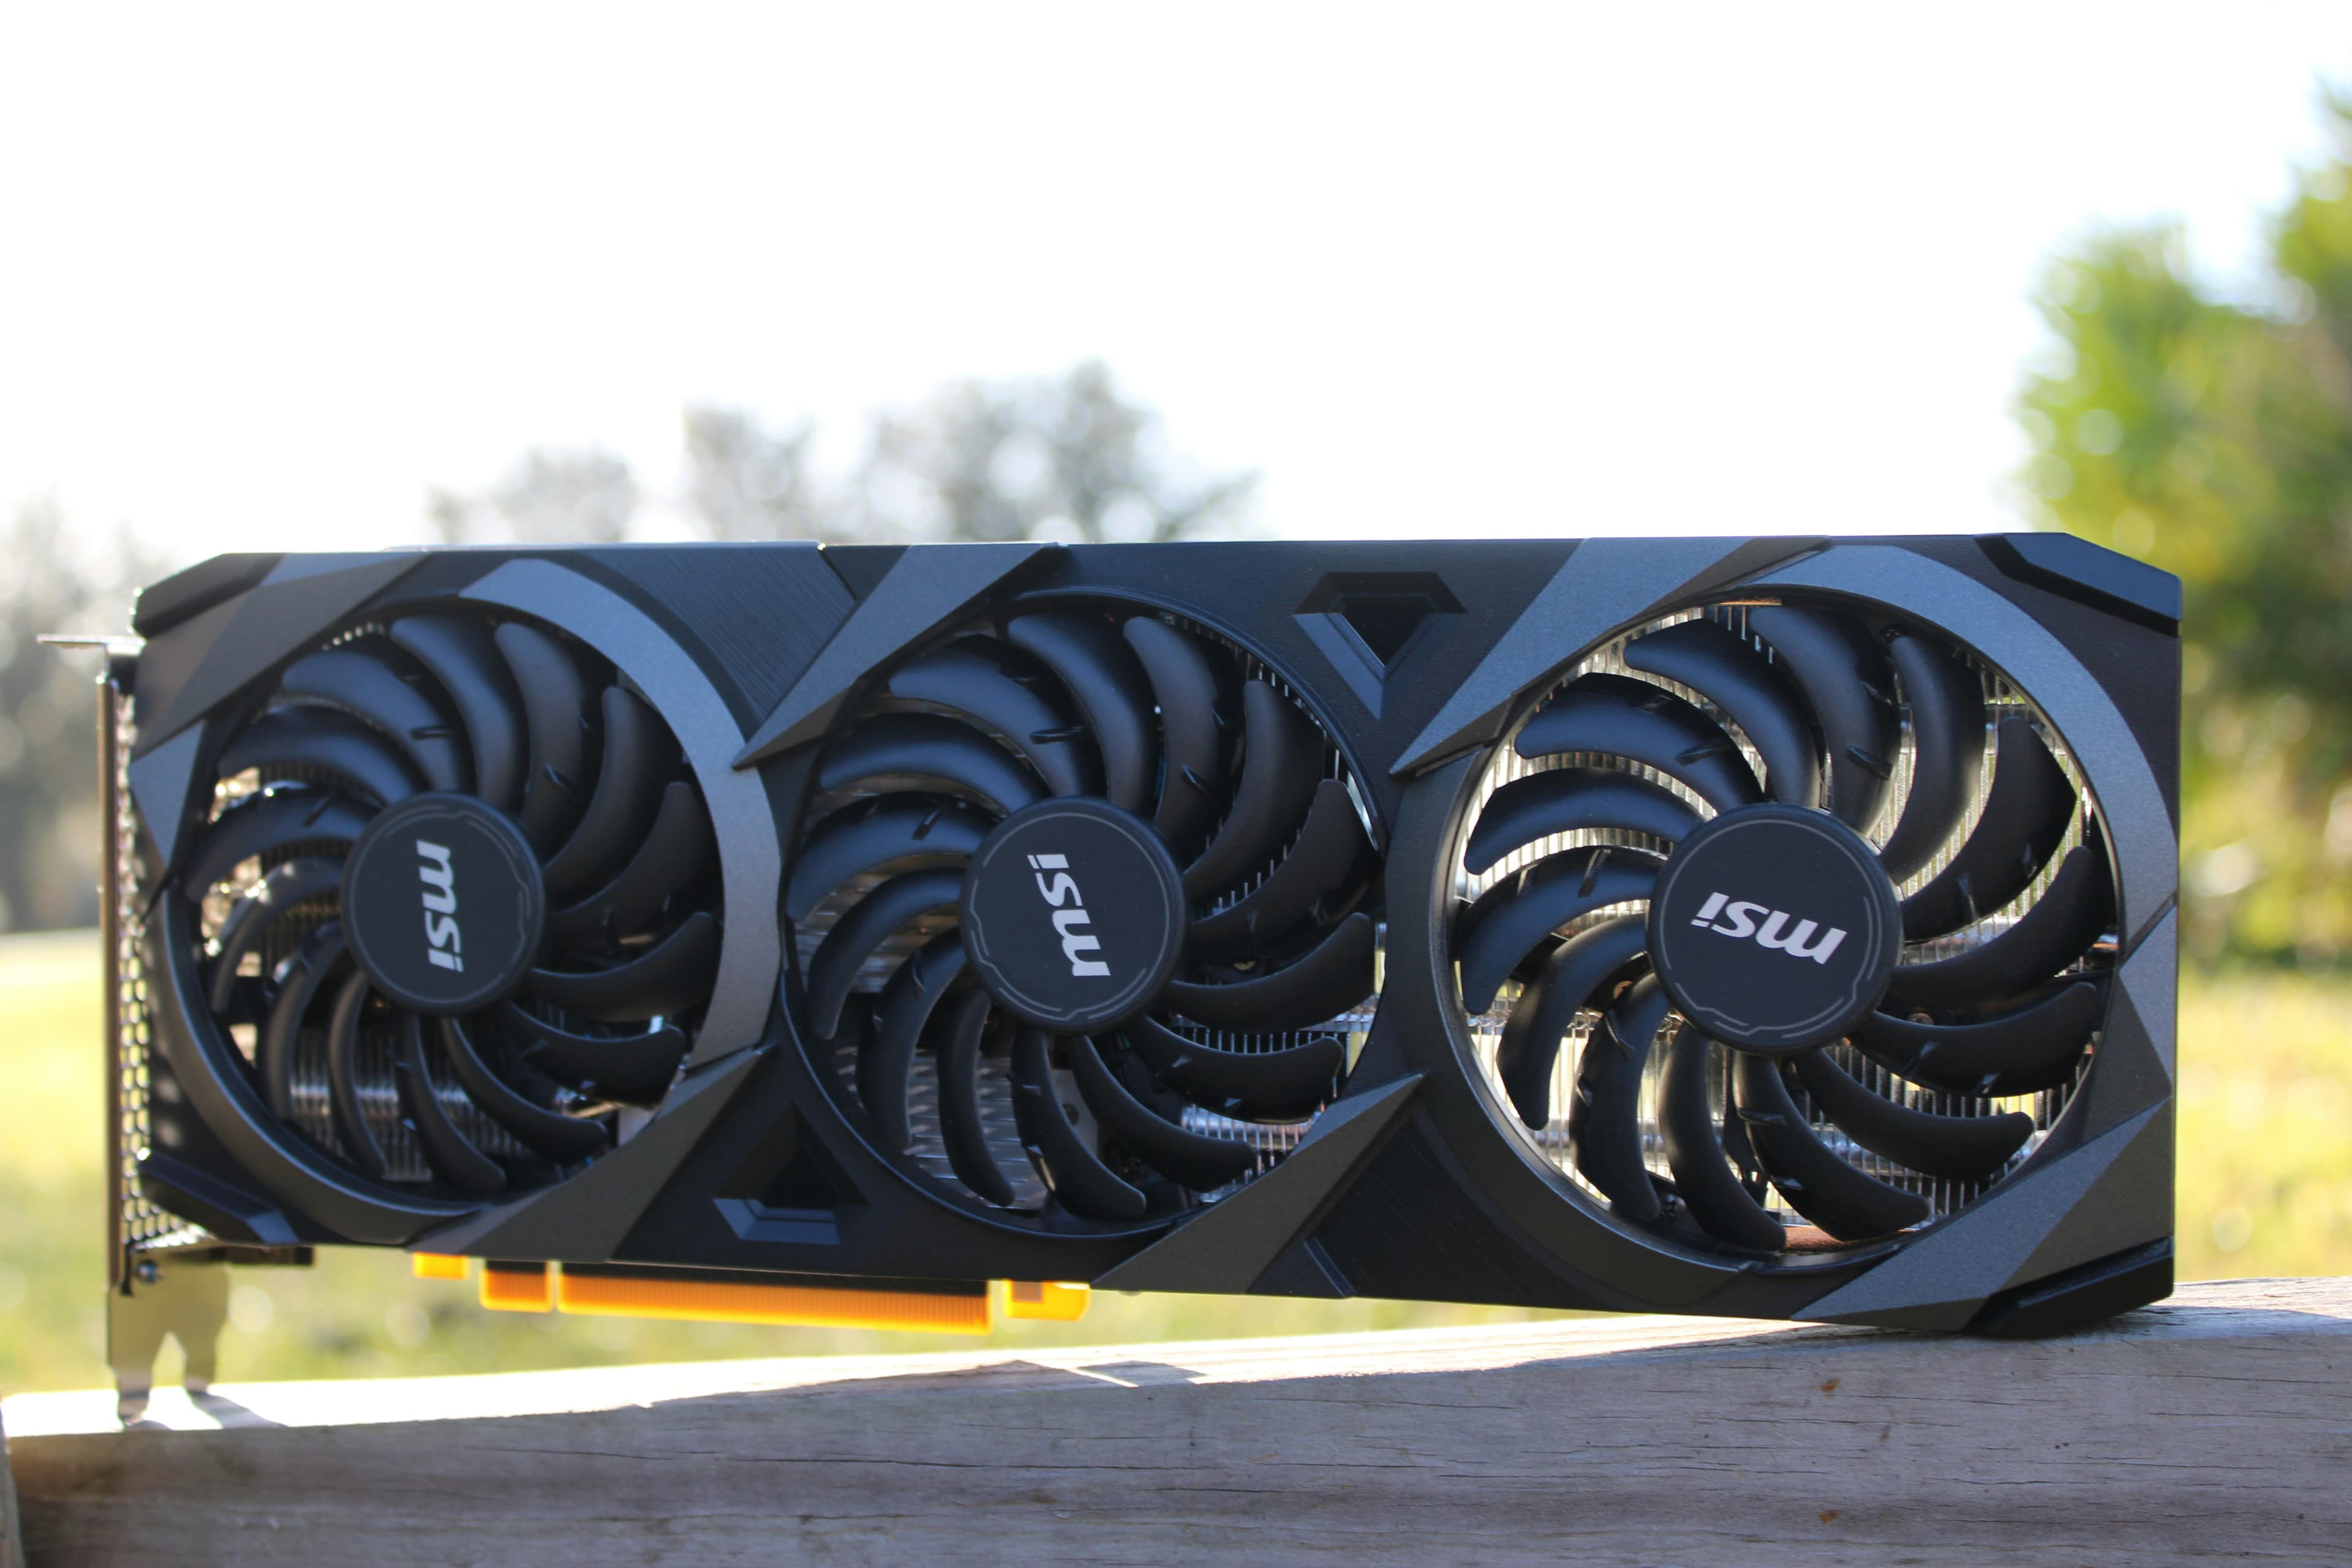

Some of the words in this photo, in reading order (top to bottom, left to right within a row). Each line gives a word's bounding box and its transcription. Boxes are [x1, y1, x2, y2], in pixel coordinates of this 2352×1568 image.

[417, 840, 464, 973] msi
[1027, 854, 1111, 977] msi
[1691, 891, 1847, 965] msi
